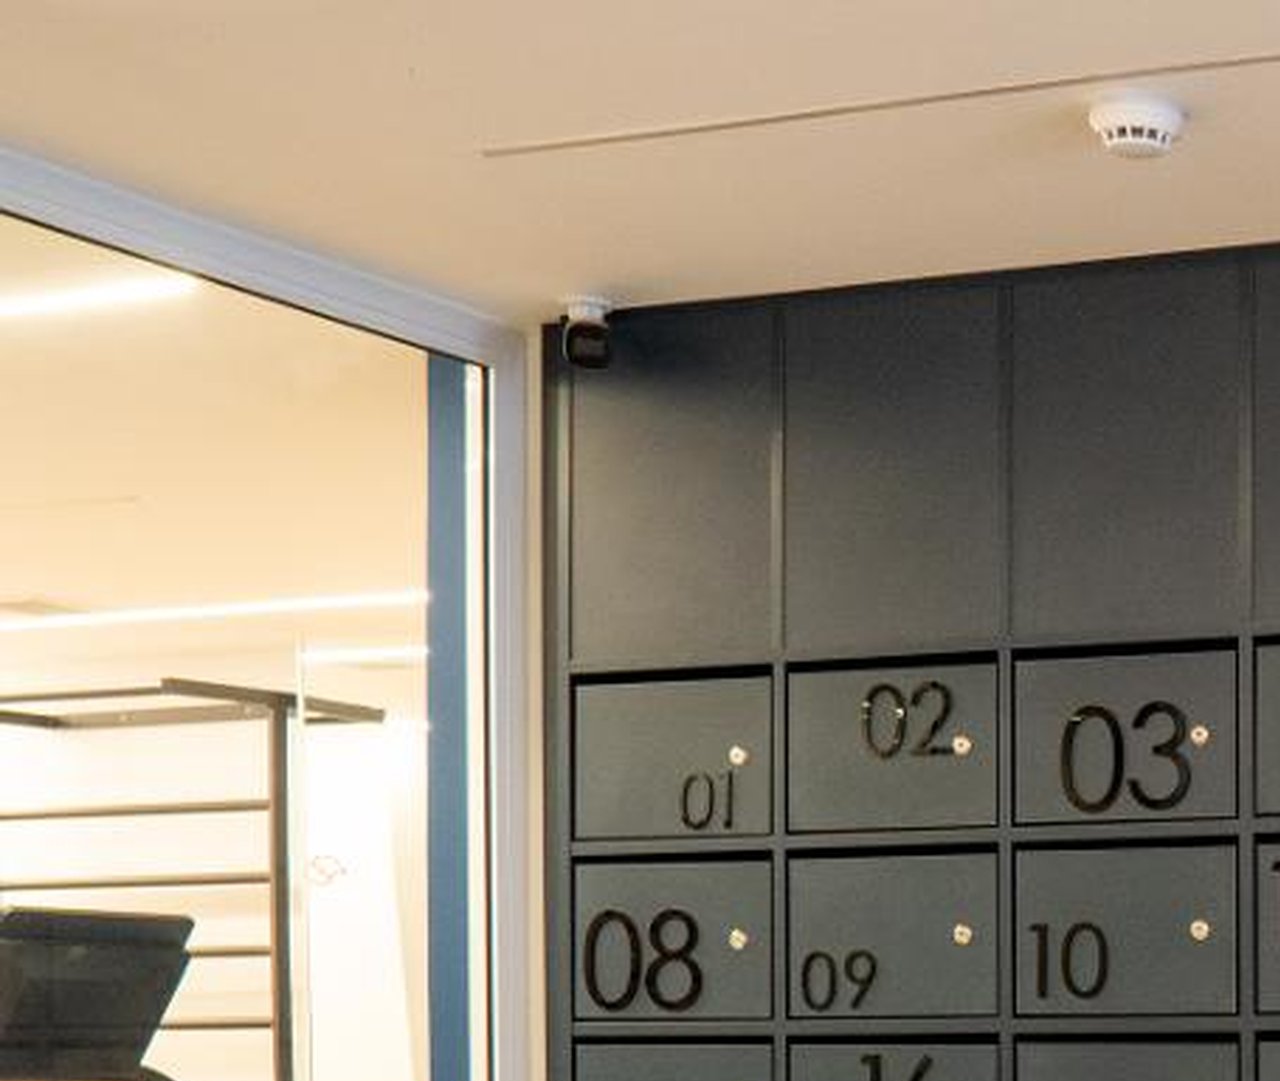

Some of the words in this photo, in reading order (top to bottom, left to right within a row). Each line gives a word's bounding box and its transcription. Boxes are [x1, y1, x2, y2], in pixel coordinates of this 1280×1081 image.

[862, 681, 954, 758] 02
[1060, 701, 1192, 813] 03
[680, 771, 734, 829] 01
[583, 909, 702, 1011] 08
[801, 949, 877, 1011] 09
[1028, 922, 1109, 1000] 10
